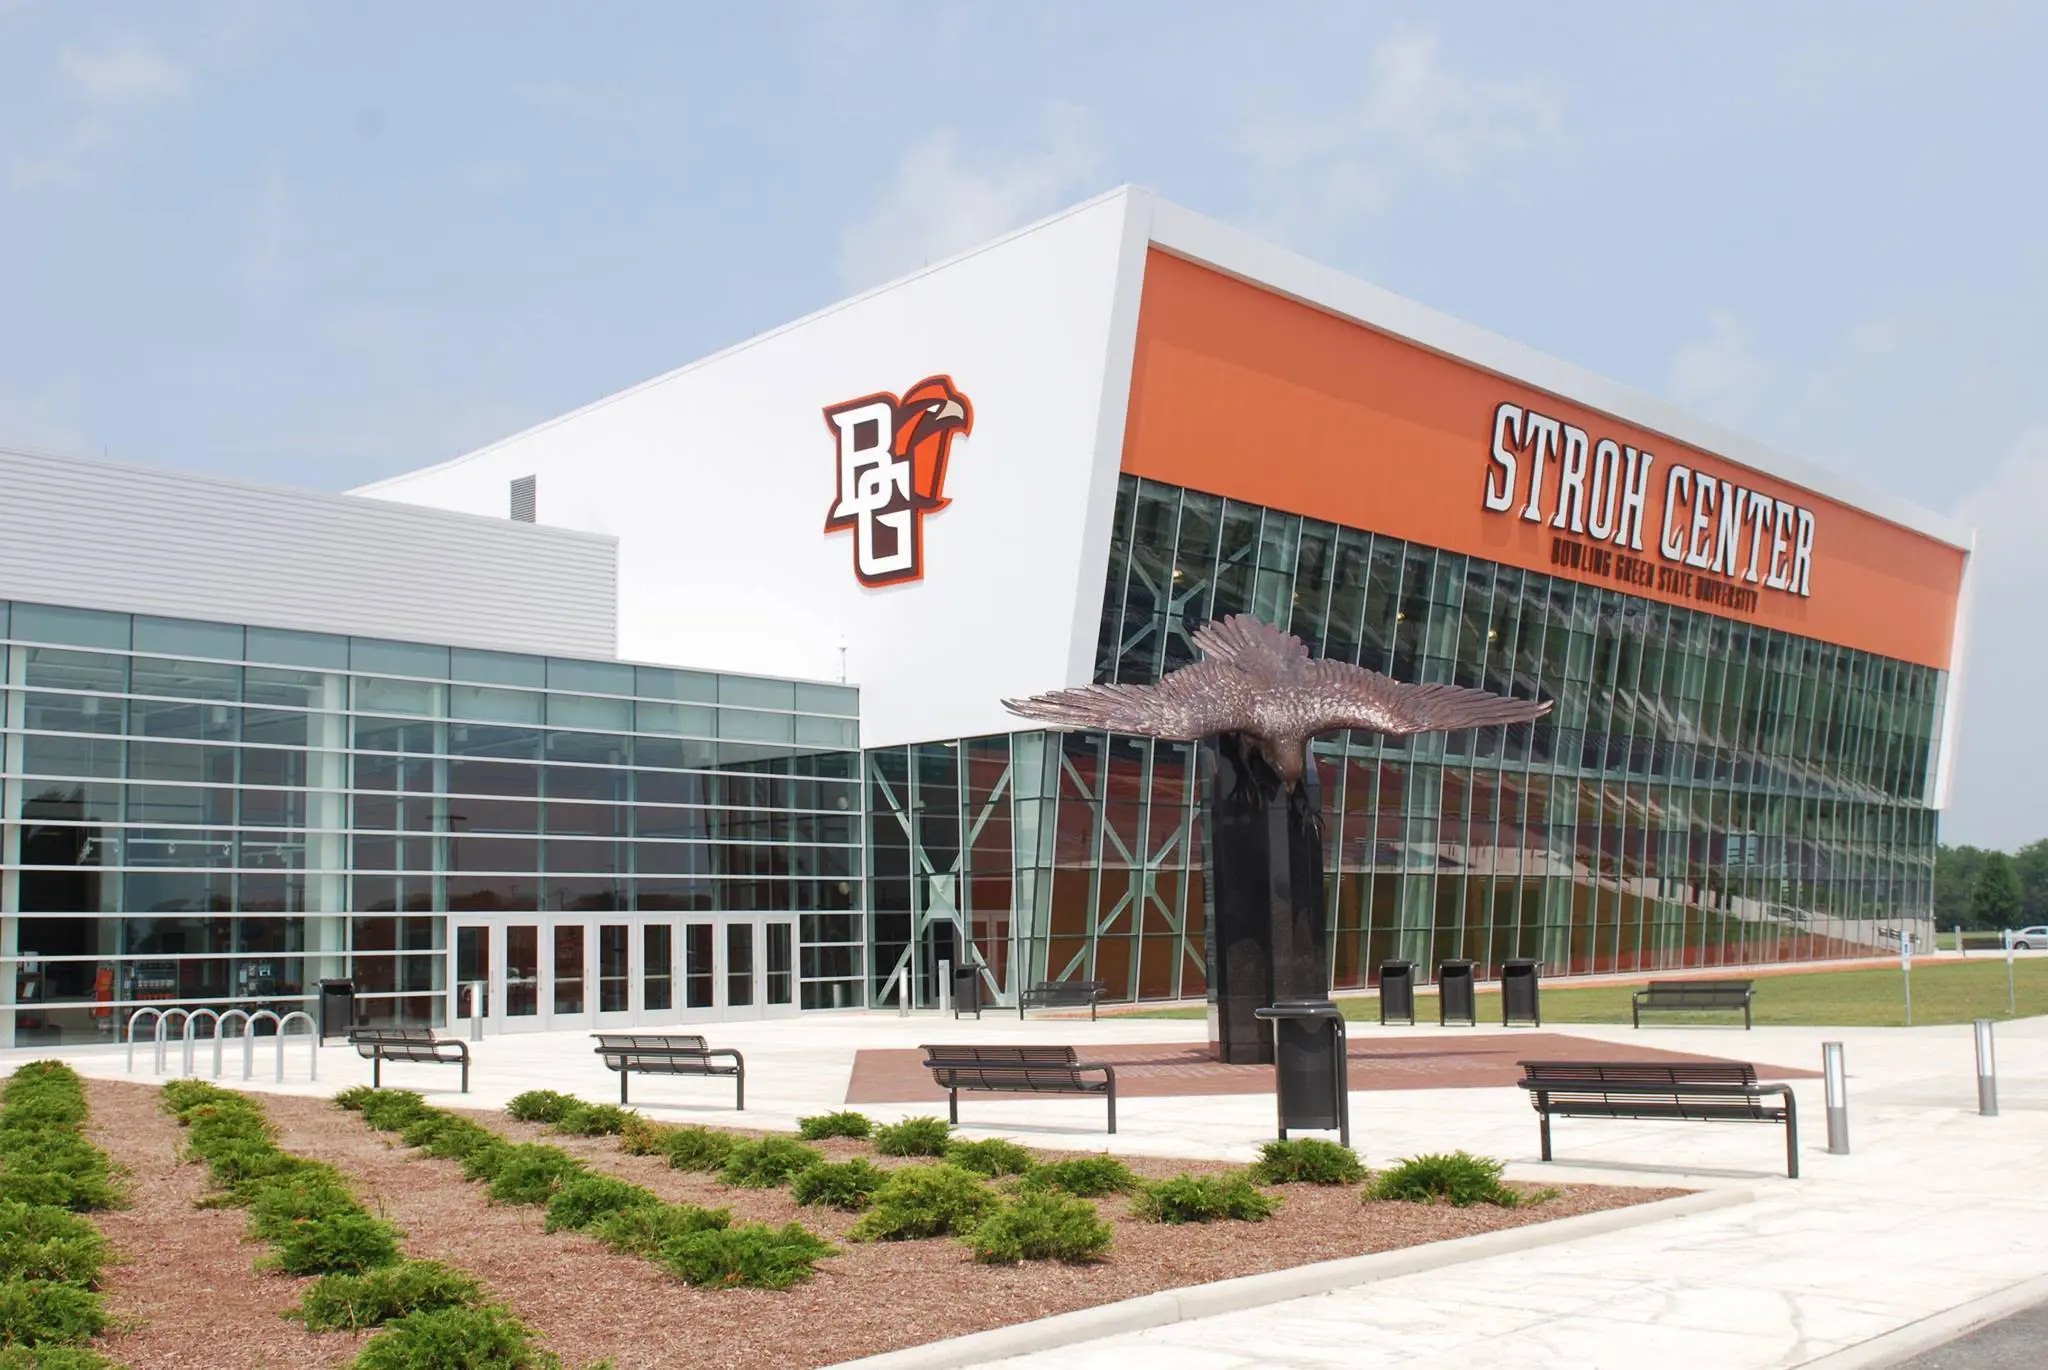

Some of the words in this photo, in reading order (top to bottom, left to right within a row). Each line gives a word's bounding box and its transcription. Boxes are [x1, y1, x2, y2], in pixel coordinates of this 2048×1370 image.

[1484, 402, 1654, 551] STROH
[1660, 464, 1816, 597] CENTER
[1551, 537, 1612, 577] BOWLING
[1616, 554, 1655, 588] GREEN
[1658, 565, 1693, 597] STATE
[1695, 575, 1759, 613] UNIVERSITY
